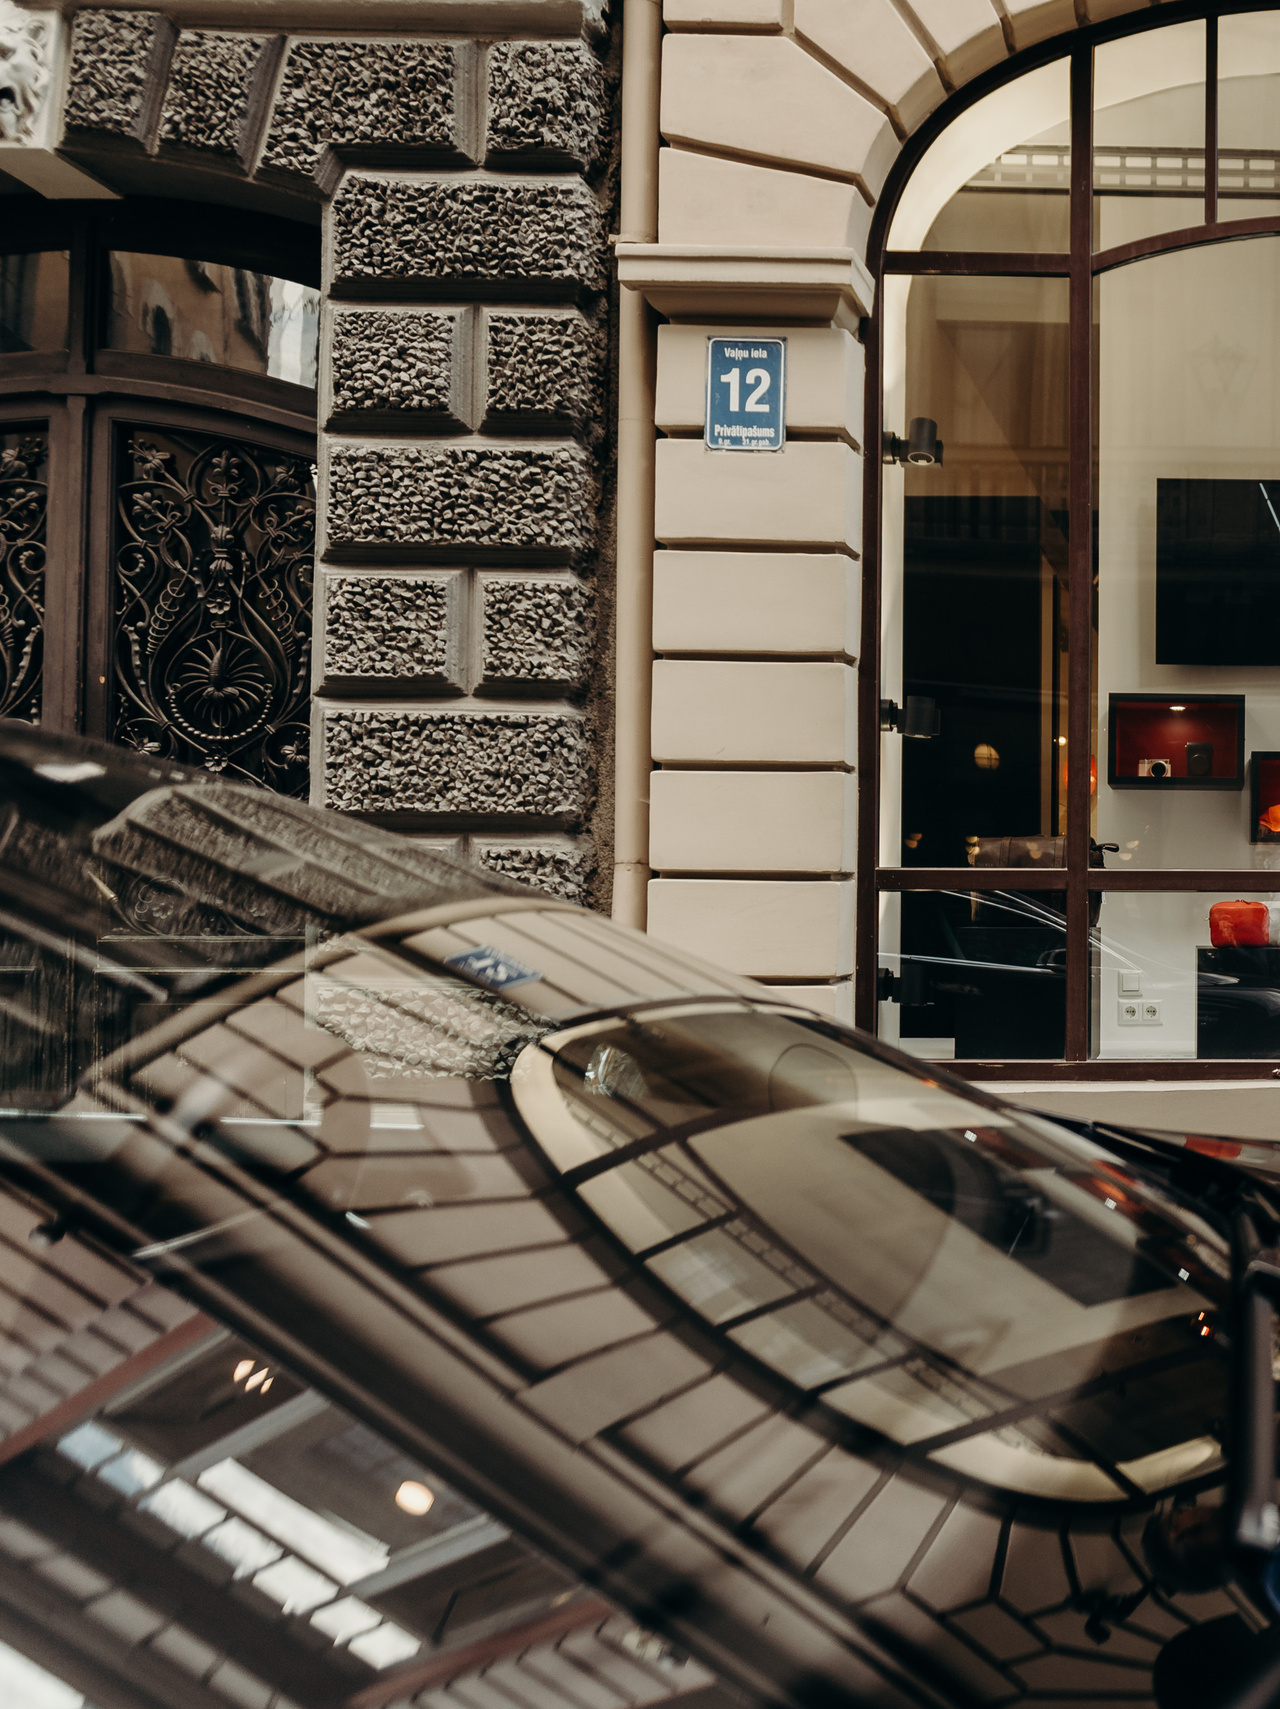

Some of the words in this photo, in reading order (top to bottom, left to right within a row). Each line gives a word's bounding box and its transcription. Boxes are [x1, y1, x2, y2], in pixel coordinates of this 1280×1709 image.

[724, 347, 749, 361] Vaļņu
[751, 348, 768, 358] iela
[720, 368, 771, 413] 12
